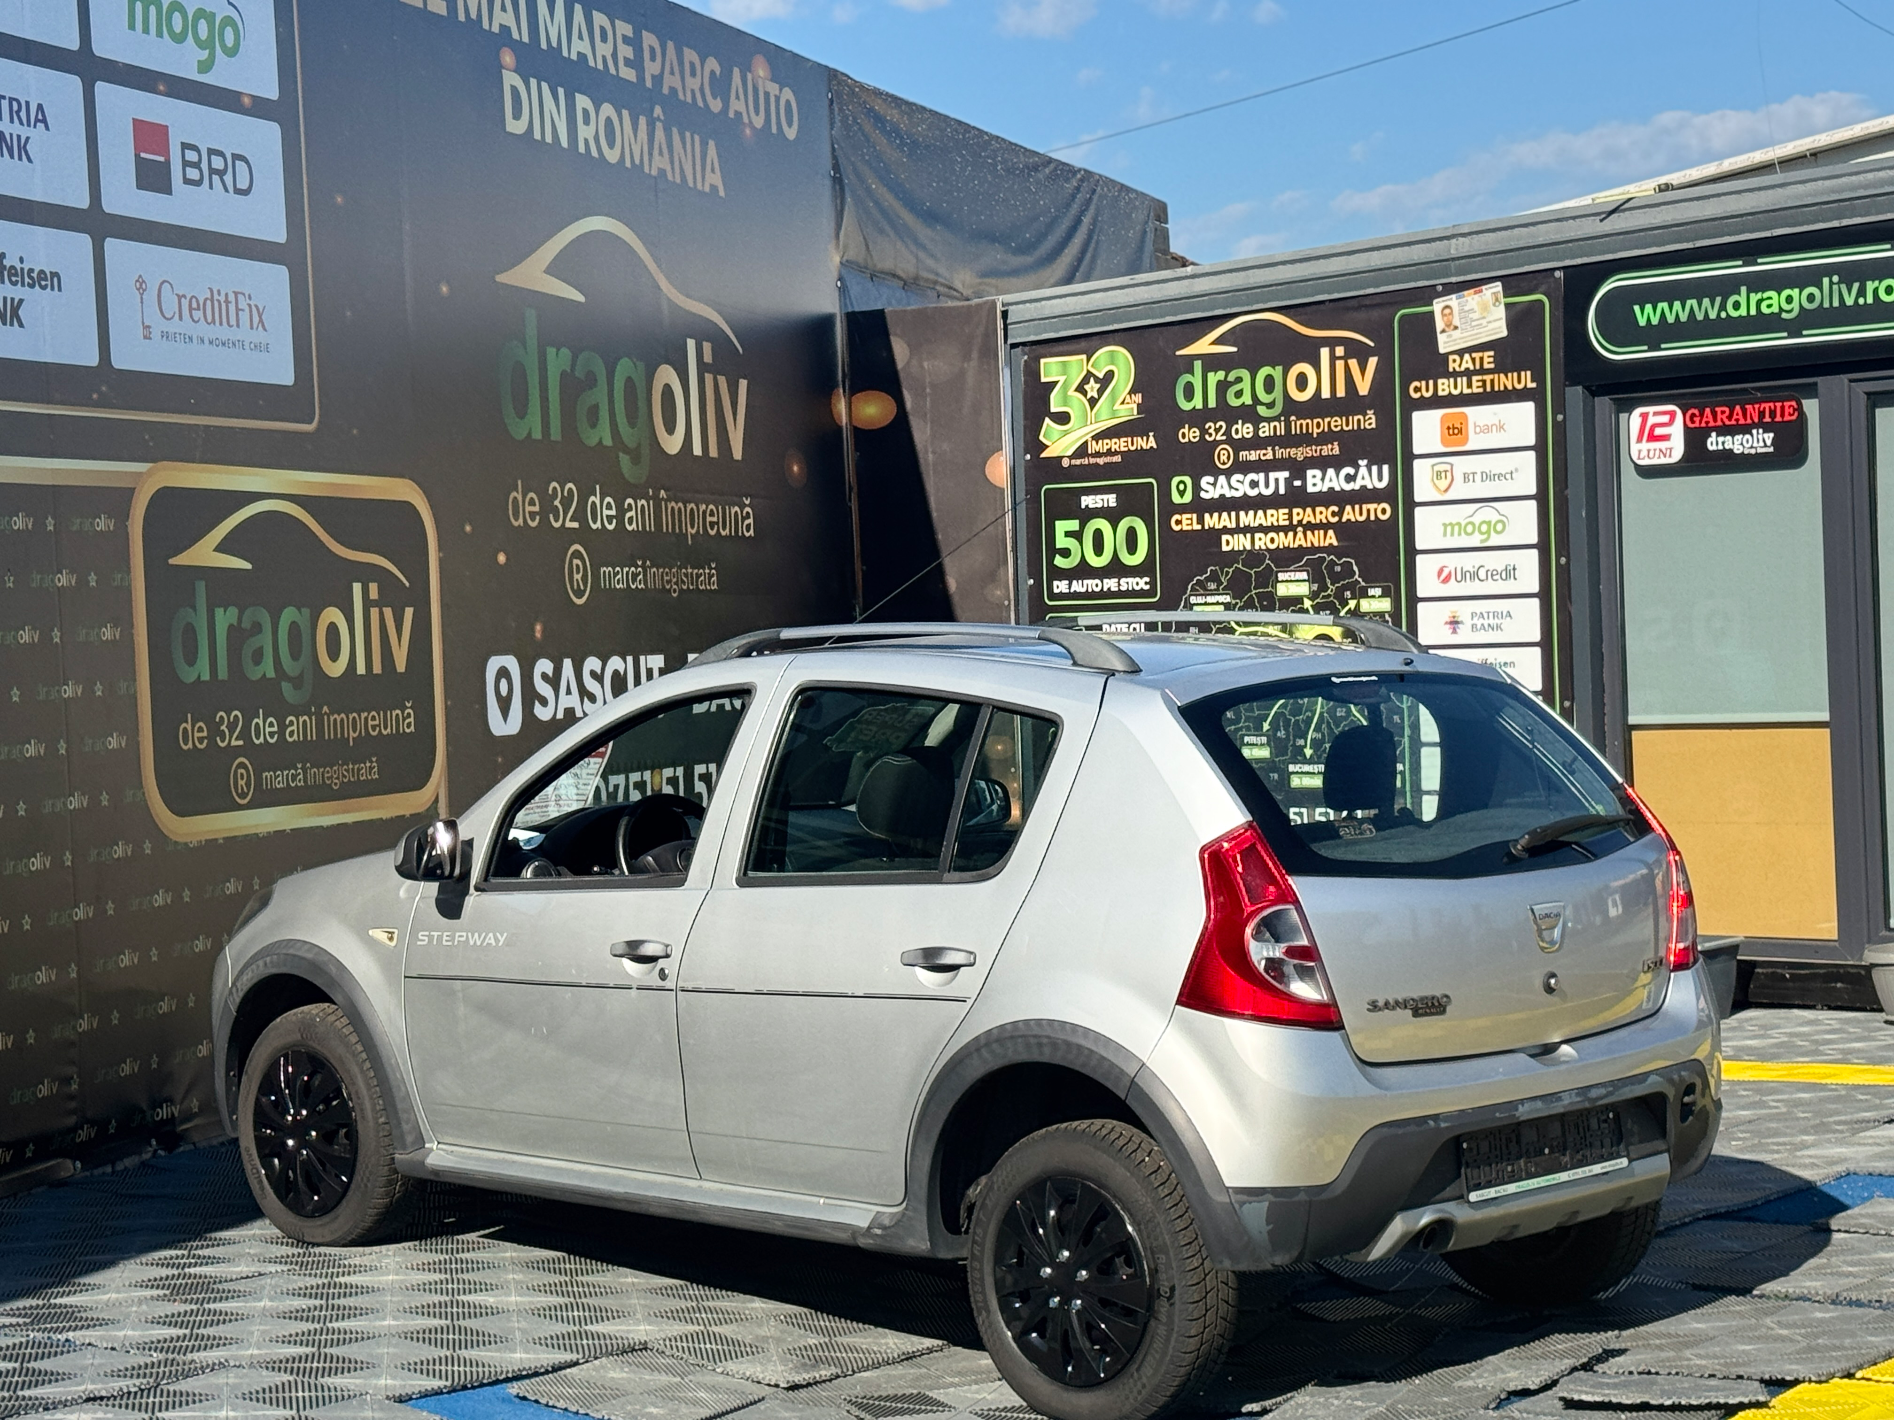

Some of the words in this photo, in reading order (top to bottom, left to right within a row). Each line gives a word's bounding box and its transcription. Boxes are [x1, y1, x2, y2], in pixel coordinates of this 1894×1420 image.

[536, 0, 637, 84] MARE
[642, 29, 722, 113] PARC
[728, 67, 799, 141] AUTO
[501, 68, 569, 149] DIN
[574, 92, 726, 198] ROMÂNIA
[180, 141, 254, 197] BRD
[156, 279, 268, 333] CreditFix
[1633, 275, 1894, 327] www.dragoliv.ro
[160, 331, 193, 345] PRIETEN
[208, 337, 246, 352] MOMENTE
[1448, 351, 1495, 372] RATE
[1175, 346, 1378, 417] dragoliv
[1409, 380, 1434, 399] CU
[1437, 371, 1537, 396] BULETINUL
[501, 307, 748, 485] dragoliv
[1178, 424, 1200, 443] de
[1204, 421, 1227, 441] 32
[1231, 419, 1254, 439] de
[1258, 417, 1286, 437] ani
[1289, 410, 1377, 437] împreună
[1635, 409, 1677, 444] 12
[1685, 400, 1798, 428] GARANTIE
[1446, 422, 1463, 437] tbi
[1473, 420, 1506, 435] bank
[1707, 428, 1774, 454] dragoliv
[1239, 446, 1273, 462] marcă
[1274, 442, 1340, 461] înregistrată
[1637, 447, 1673, 460] LUNI
[1200, 471, 1289, 499] SASCUT
[1306, 460, 1390, 495] BACĂU
[1435, 469, 1449, 481] BT
[1463, 472, 1477, 484] BT
[508, 479, 540, 527] de
[548, 481, 579, 529] 32
[587, 484, 616, 530] de
[624, 488, 655, 533] ani
[660, 489, 755, 545] împreună
[1080, 494, 1117, 509] PESTE
[1170, 513, 1202, 532] CEL
[1204, 511, 1237, 530] MAI
[1239, 508, 1291, 528] MARE
[1292, 505, 1339, 525] PARC
[1341, 502, 1392, 522] AUTO
[1053, 516, 1149, 569] 500
[1221, 533, 1252, 552] DIN
[1253, 528, 1338, 550] ROMÂNIA
[1442, 518, 1507, 545] mogo
[600, 560, 644, 589] marcă
[646, 560, 718, 597] înregistrată
[1053, 580, 1069, 594] DE
[1070, 579, 1099, 593] AUTO
[1100, 578, 1114, 592] PE
[1115, 577, 1150, 591] STOC
[1454, 564, 1517, 583] UniCredit
[1471, 610, 1513, 621] PATRIA
[1471, 623, 1503, 633] BANK
[170, 580, 415, 705] dragoliv
[179, 714, 208, 751] de
[215, 710, 244, 747] 32
[251, 708, 278, 744] de
[285, 706, 317, 741] ani
[322, 701, 415, 746] împreună
[262, 763, 304, 790] marcă
[306, 757, 379, 789] înregistrată
[417, 932, 508, 946] STEPWAY
[1366, 993, 1452, 1013] SANDERO
